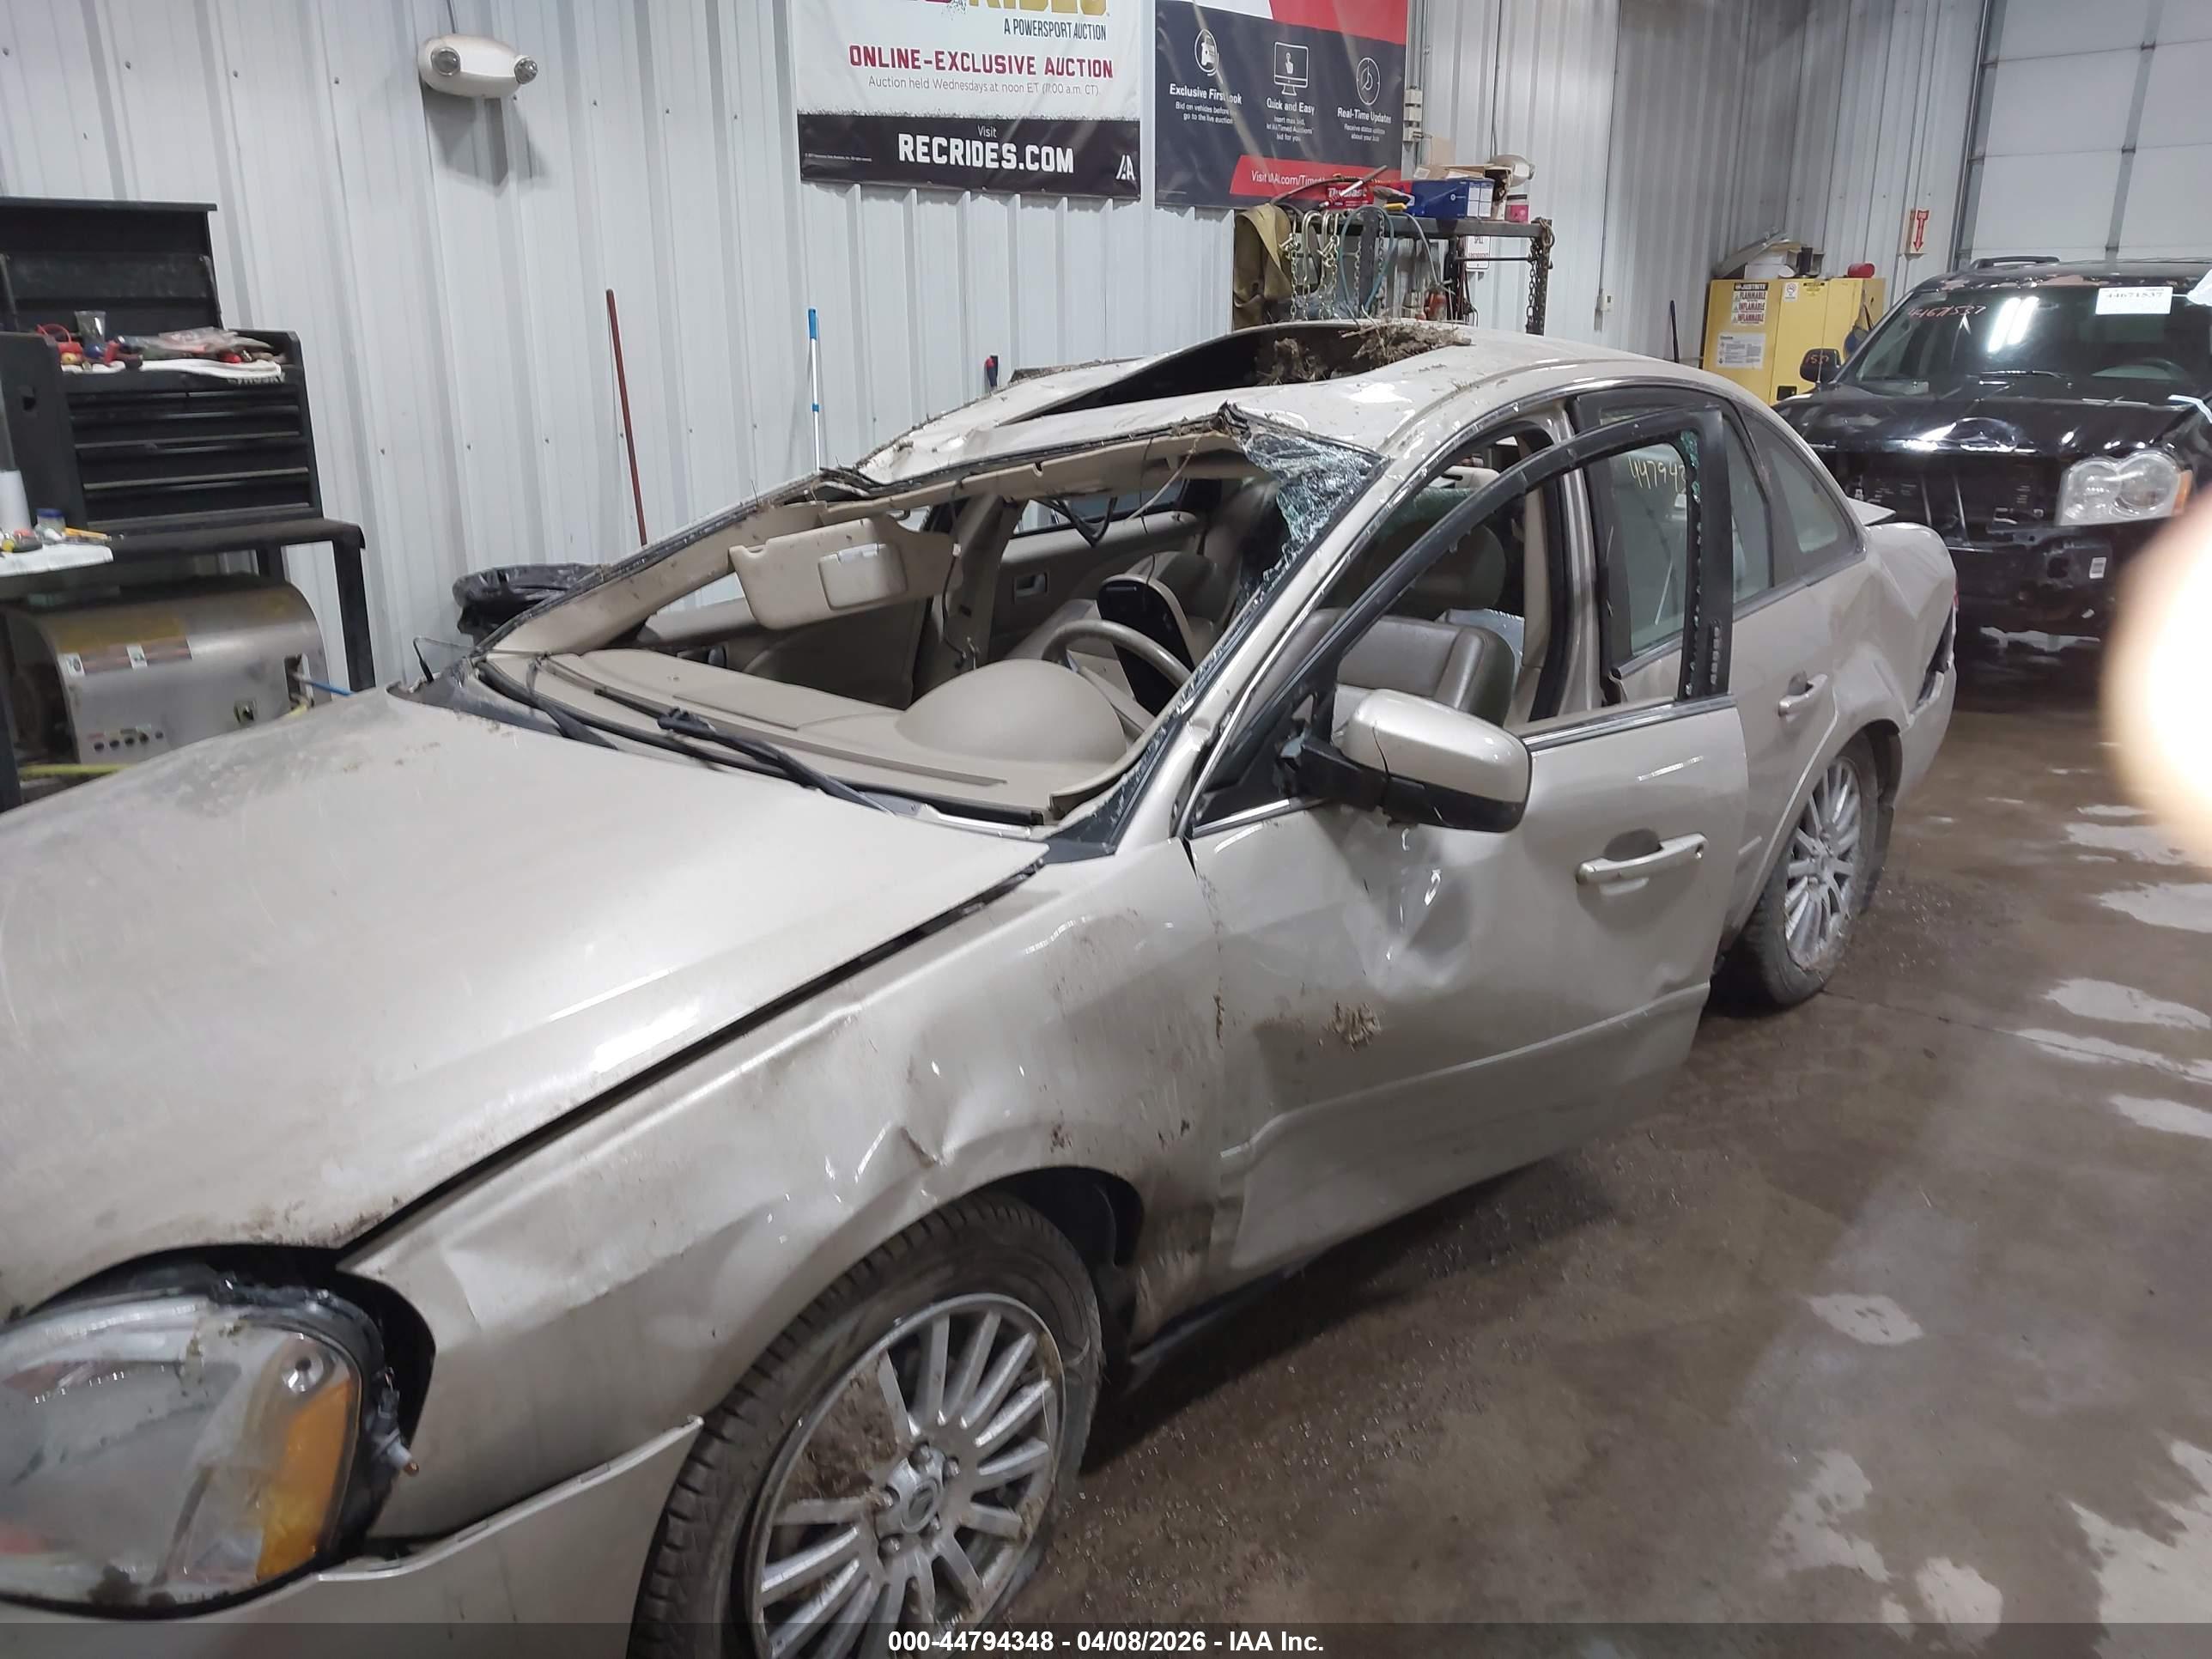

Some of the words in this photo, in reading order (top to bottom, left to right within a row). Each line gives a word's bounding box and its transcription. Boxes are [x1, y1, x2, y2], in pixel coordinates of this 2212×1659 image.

[1004, 18, 1011, 35] A
[1013, 19, 1073, 40] POWERSPORT
[1073, 24, 1107, 41] AUCTION
[849, 45, 1036, 76] ONLINE-EXCLUSIVE
[1044, 57, 1114, 79] AUCTION
[868, 75, 907, 89] Auction
[909, 76, 930, 90] held
[933, 78, 988, 94] Wednesdays
[989, 82, 999, 93] at
[1002, 84, 1024, 94] noon
[1027, 82, 1039, 94] ET
[1170, 83, 1207, 99] Exclusive
[1209, 88, 1225, 101] First
[1176, 101, 1185, 110] Bid
[1194, 104, 1212, 113] vehicles
[1267, 97, 1283, 111] Quick
[1285, 100, 1297, 112] and
[1299, 102, 1315, 116] Easy
[1337, 106, 1370, 121] Real-Time
[1370, 111, 1391, 125] Updates
[977, 125, 997, 138] Visit
[897, 133, 1074, 173] RECRIDES.COM
[1251, 170, 1267, 183] Visit
